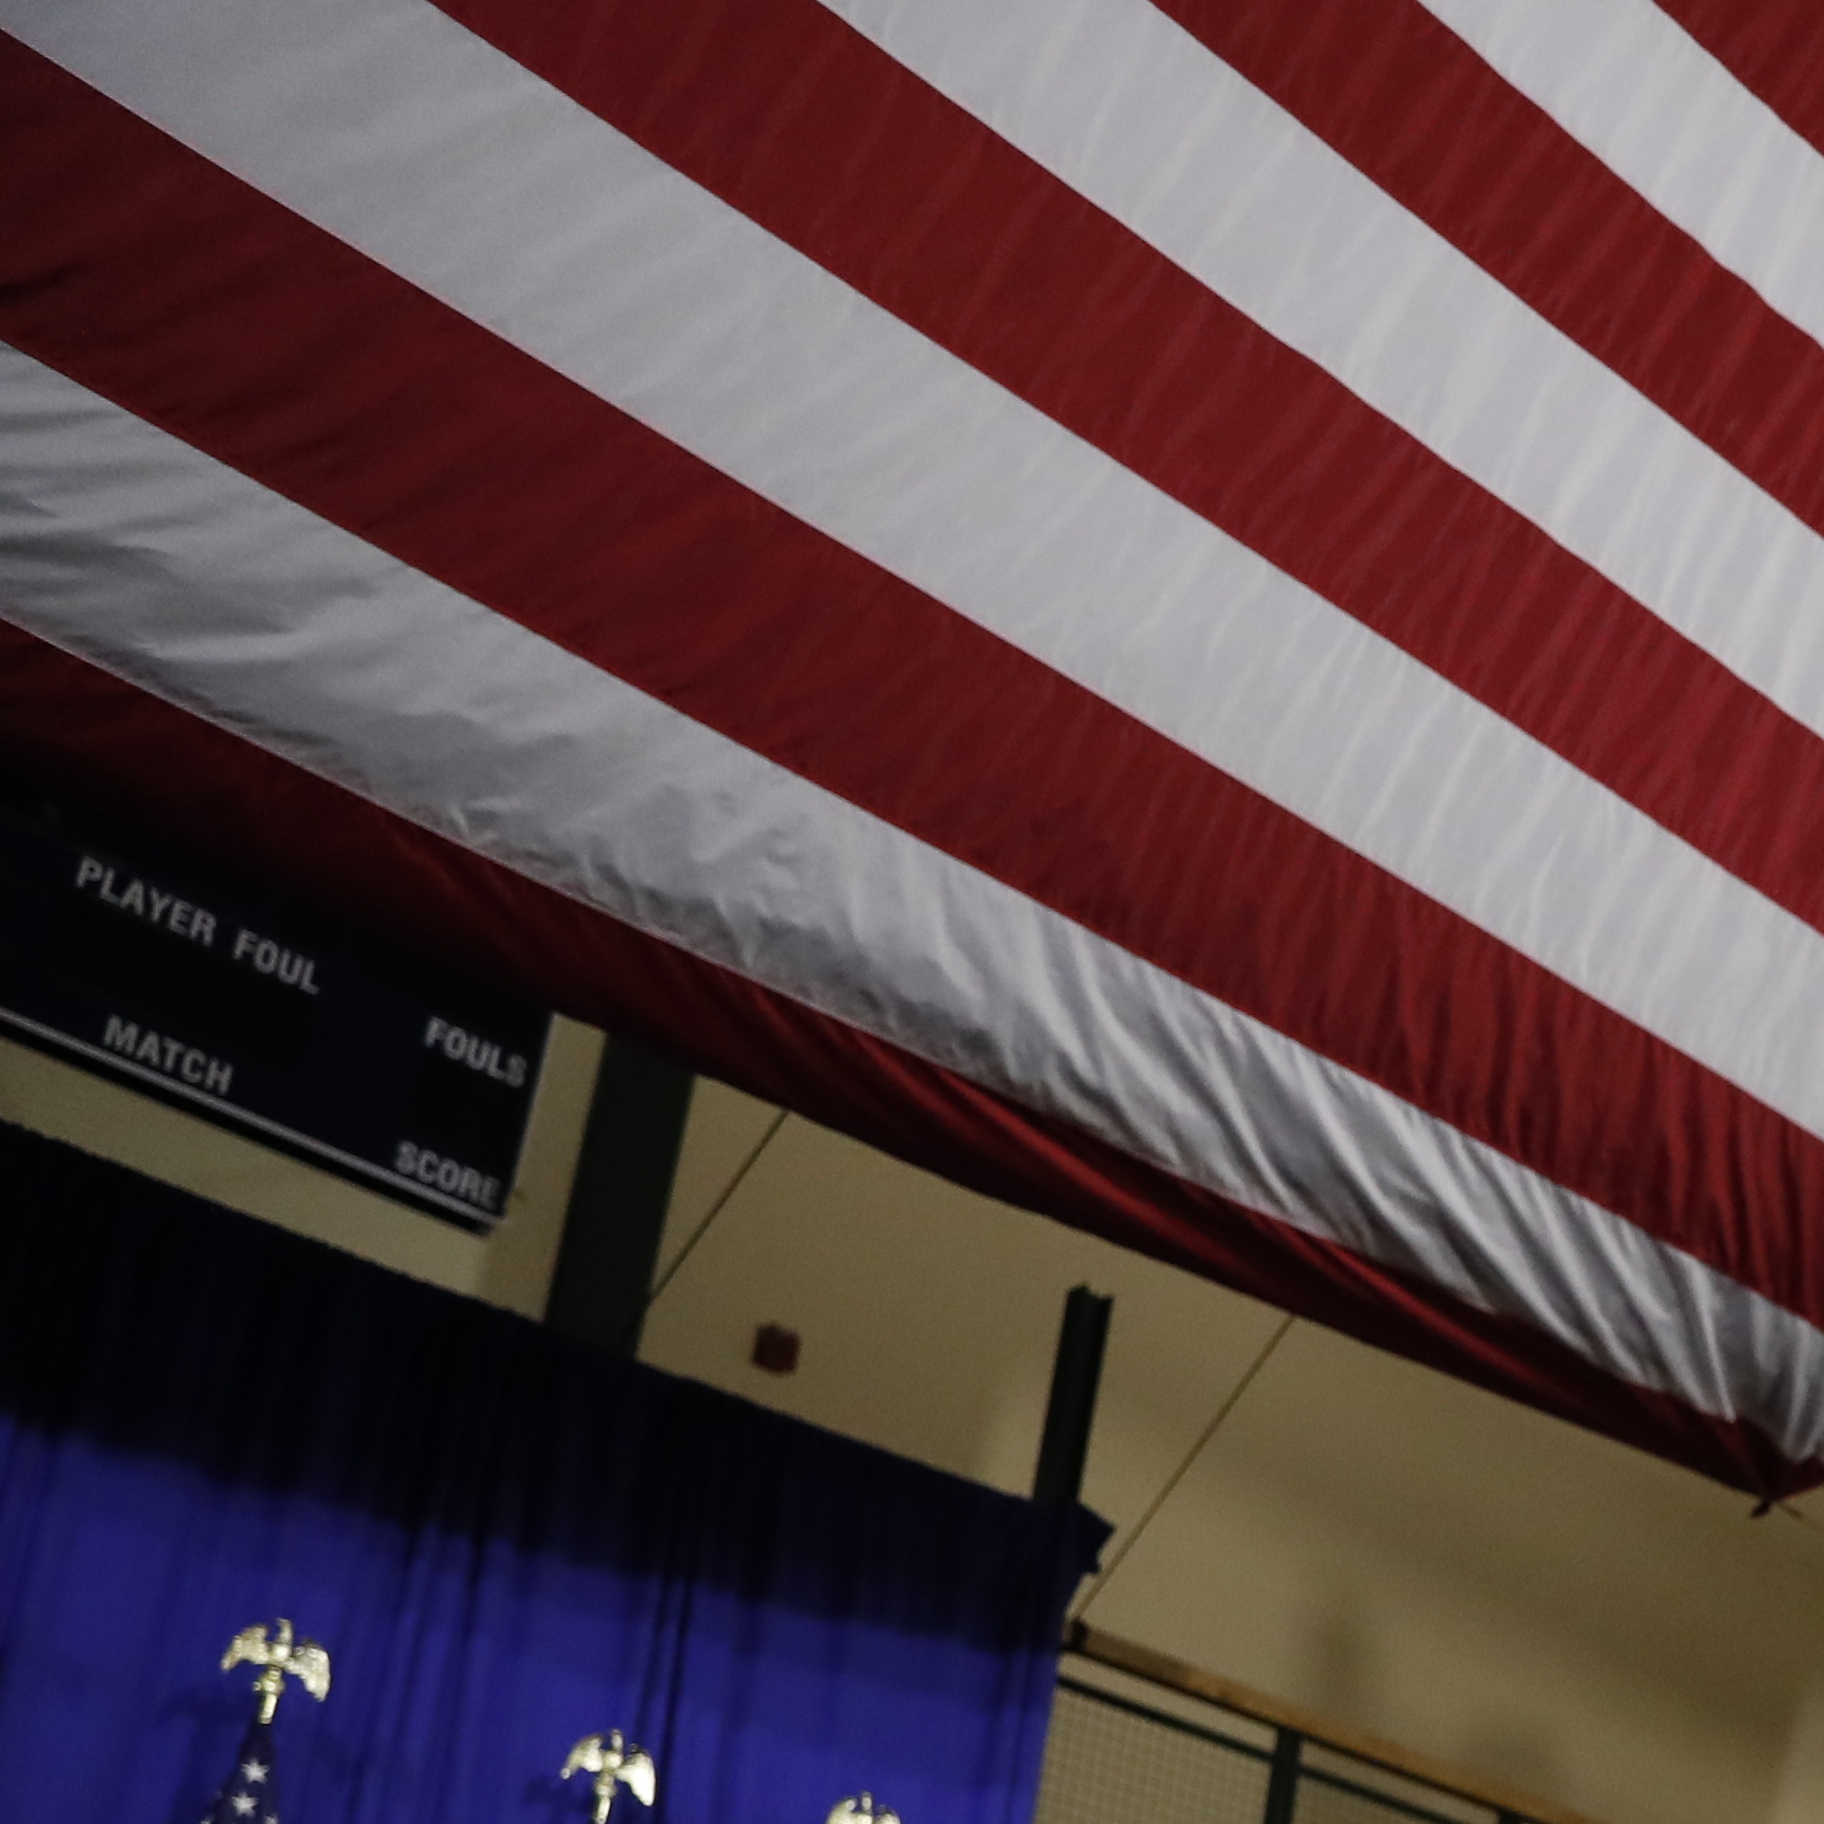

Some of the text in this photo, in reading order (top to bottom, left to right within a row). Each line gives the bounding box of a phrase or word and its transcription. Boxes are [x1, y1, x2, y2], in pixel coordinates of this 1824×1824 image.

[76, 855, 320, 996] PLAYER FOUL
[103, 1013, 234, 1097] MATCH
[424, 1014, 528, 1089] FOULS
[395, 1140, 502, 1211] SCORE
